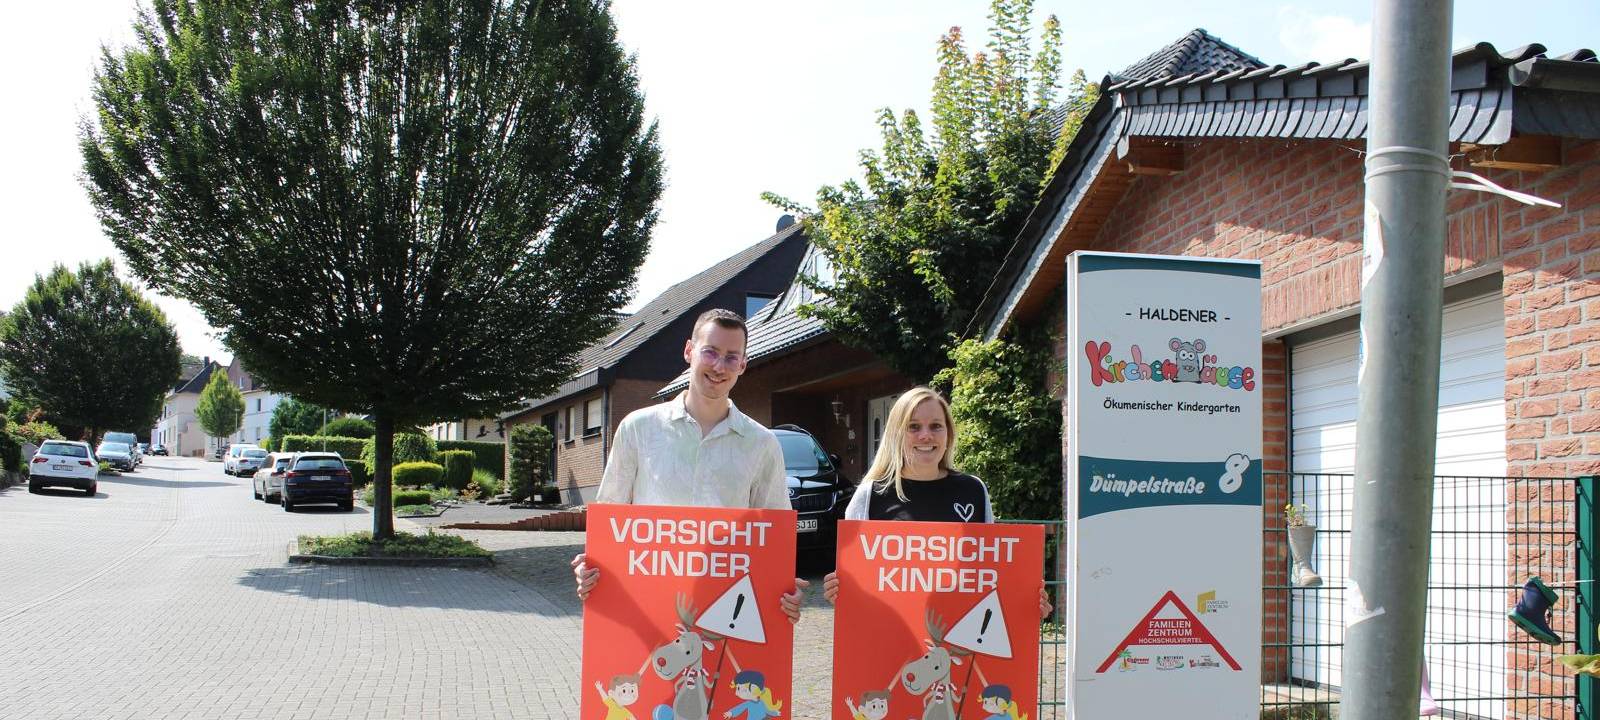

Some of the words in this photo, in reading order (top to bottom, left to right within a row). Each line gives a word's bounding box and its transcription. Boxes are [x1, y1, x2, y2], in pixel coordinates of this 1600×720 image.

[1139, 308, 1217, 323] HALDENER
[1103, 396, 1174, 412] Ökumenischer
[1177, 400, 1241, 415] Kindergarten
[1089, 473, 1206, 497] Dümpelstraße
[1218, 452, 1250, 494] 8
[609, 517, 772, 548] VORSICHT
[859, 533, 1020, 564] VORSICHT
[628, 550, 751, 578] KINDER
[877, 566, 998, 593] KINDER
[1148, 628, 1192, 637] ZENTRUM
[1149, 620, 1191, 628] FAMILIEN
